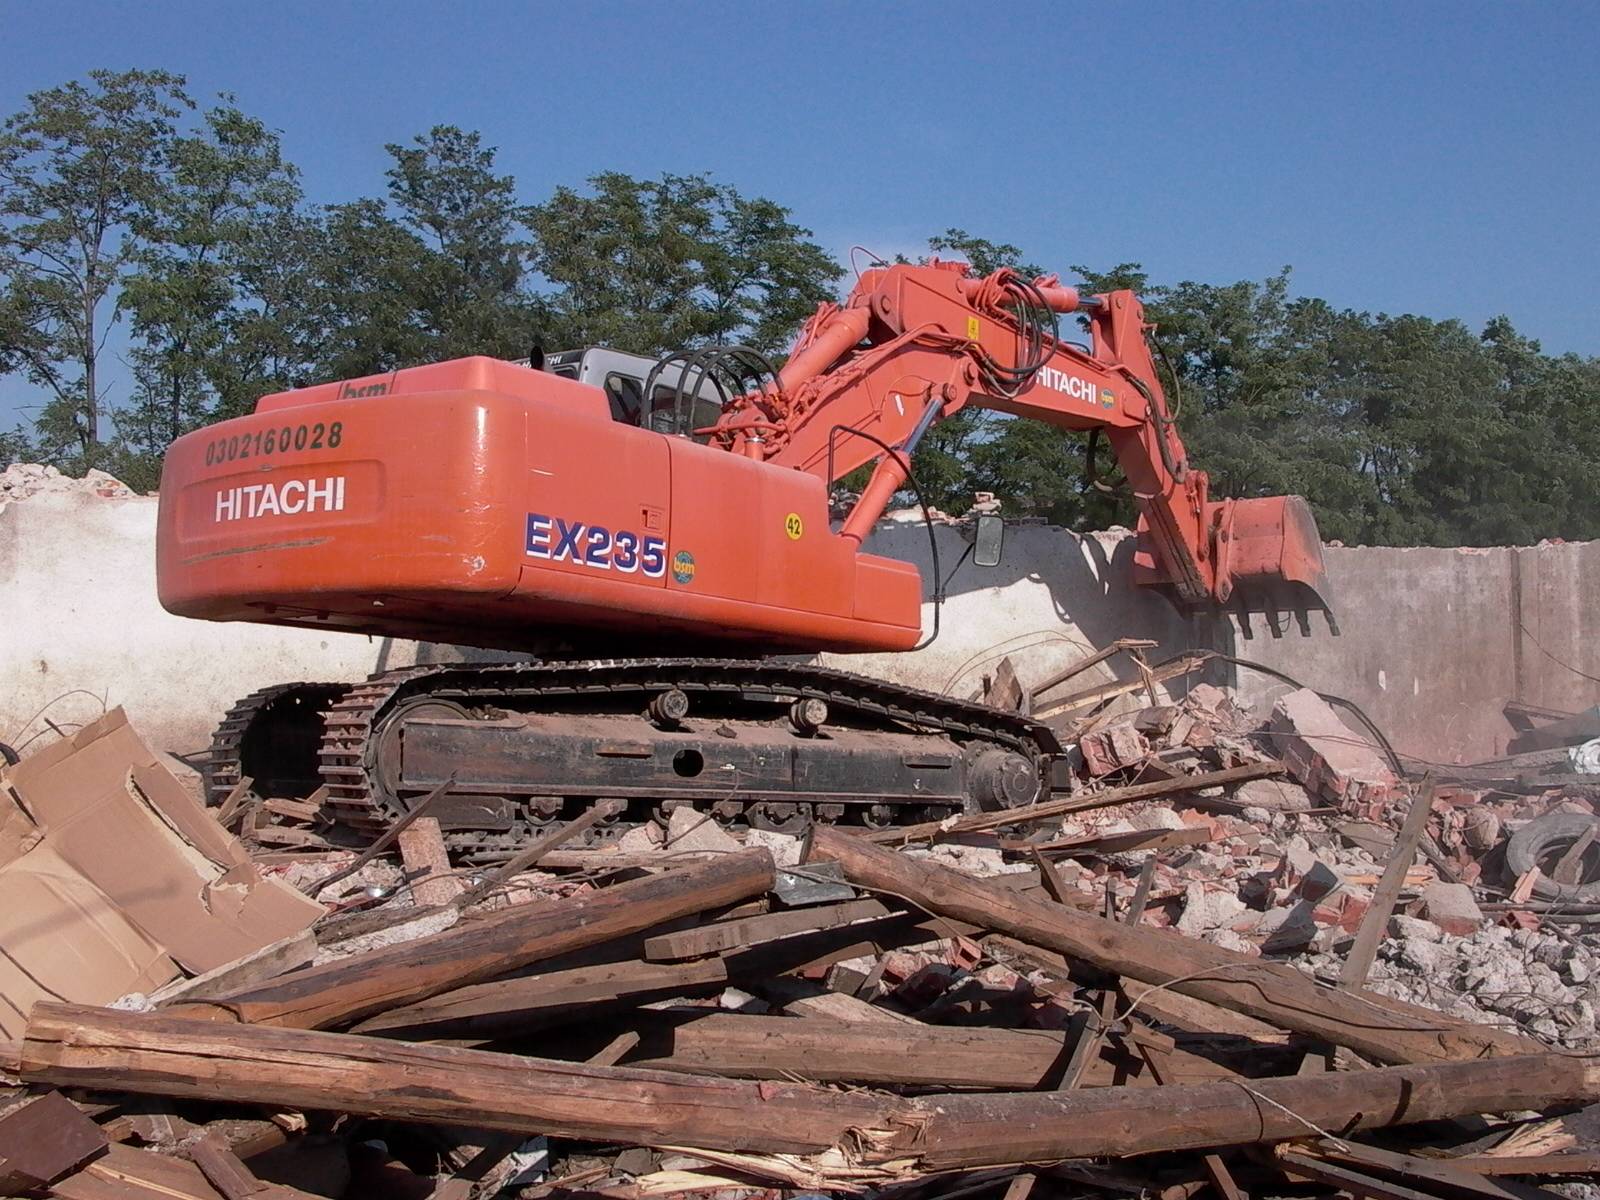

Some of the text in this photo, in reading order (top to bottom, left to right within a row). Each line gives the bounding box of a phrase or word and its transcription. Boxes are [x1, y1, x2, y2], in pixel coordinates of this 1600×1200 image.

[1036, 365, 1097, 405] HITACHI
[206, 421, 343, 466] 0302160028
[215, 476, 346, 522] HITACHI
[526, 512, 667, 578] EX235
[787, 517, 801, 535] 42
[673, 556, 695, 575] bsm
